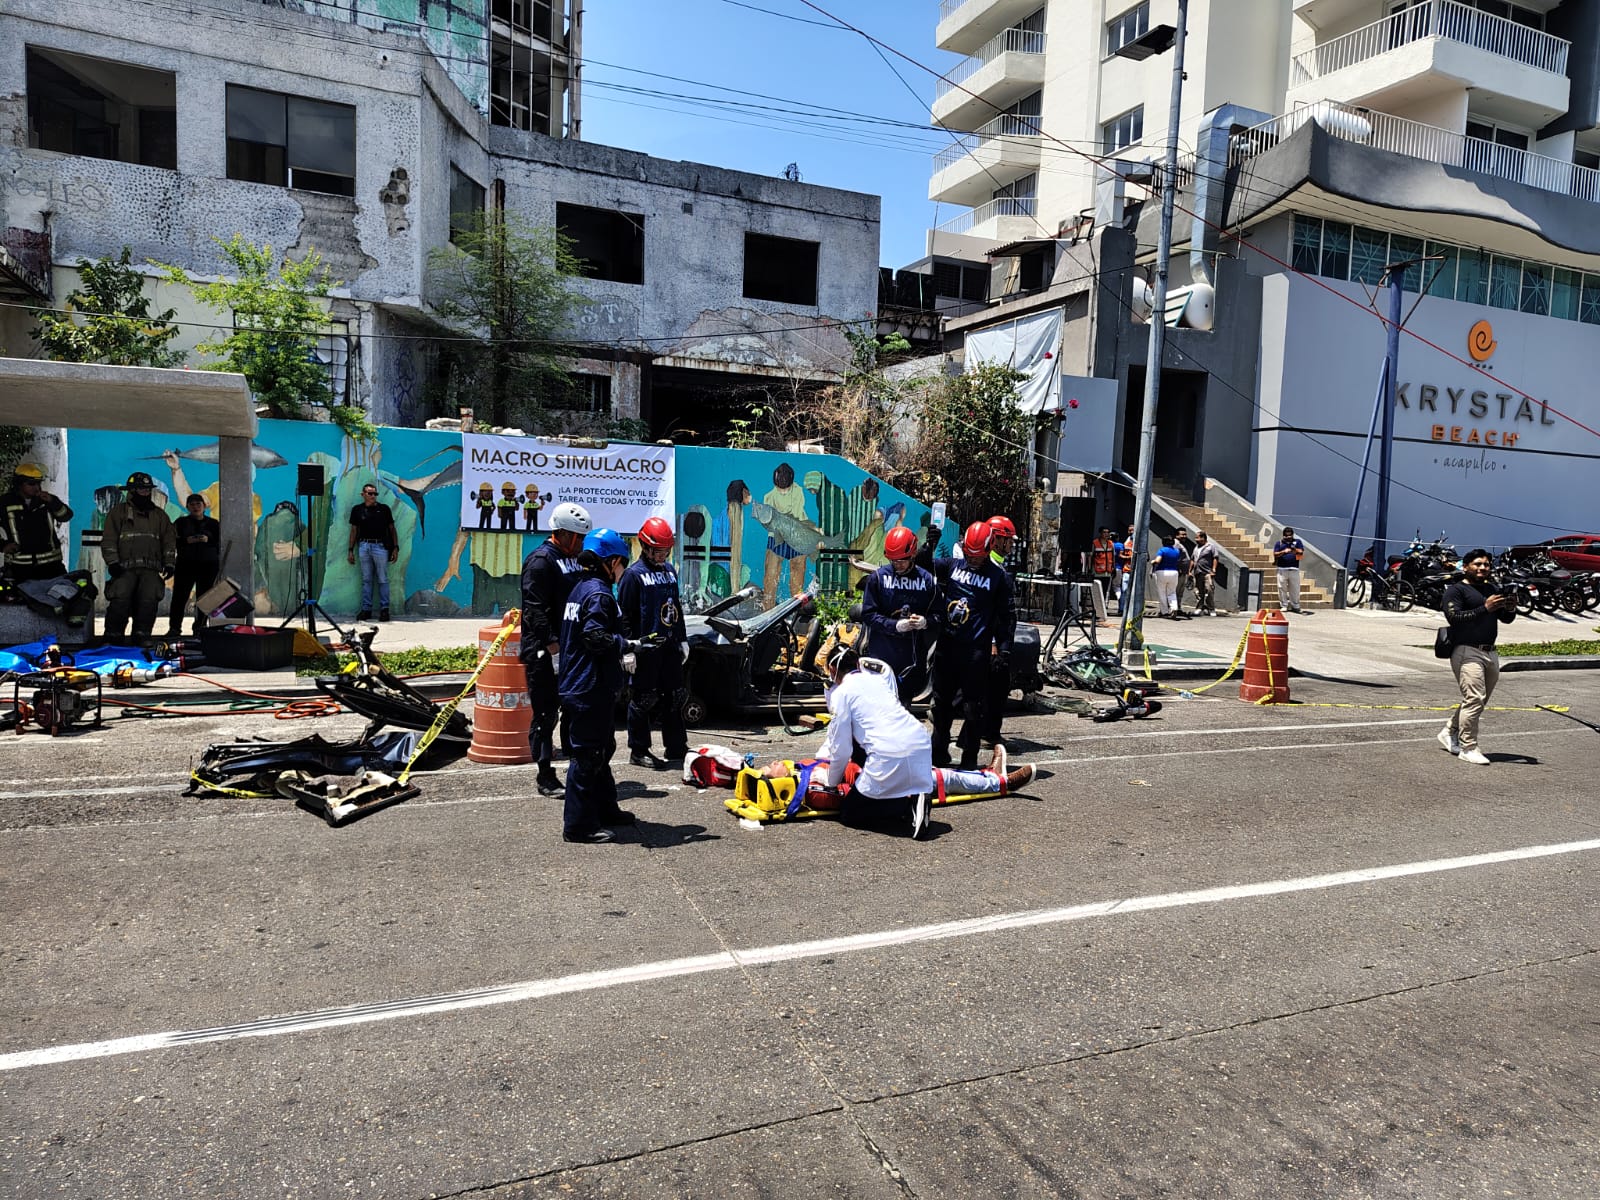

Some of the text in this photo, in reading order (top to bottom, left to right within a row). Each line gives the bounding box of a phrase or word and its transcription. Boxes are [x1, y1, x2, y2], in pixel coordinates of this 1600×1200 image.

[1394, 382, 1555, 425] KRYSTAL
[1431, 424, 1517, 446] BEACH
[471, 448, 666, 474] MACRO SIMULACRO
[1443, 449, 1497, 478] acapulco
[558, 495, 584, 503] TAREA
[600, 497, 627, 505] TODAS
[573, 487, 626, 496] PROTECCIÓN
[627, 489, 647, 497] CIVIL
[883, 575, 927, 591] MARINA
[950, 568, 991, 591] MARINA
